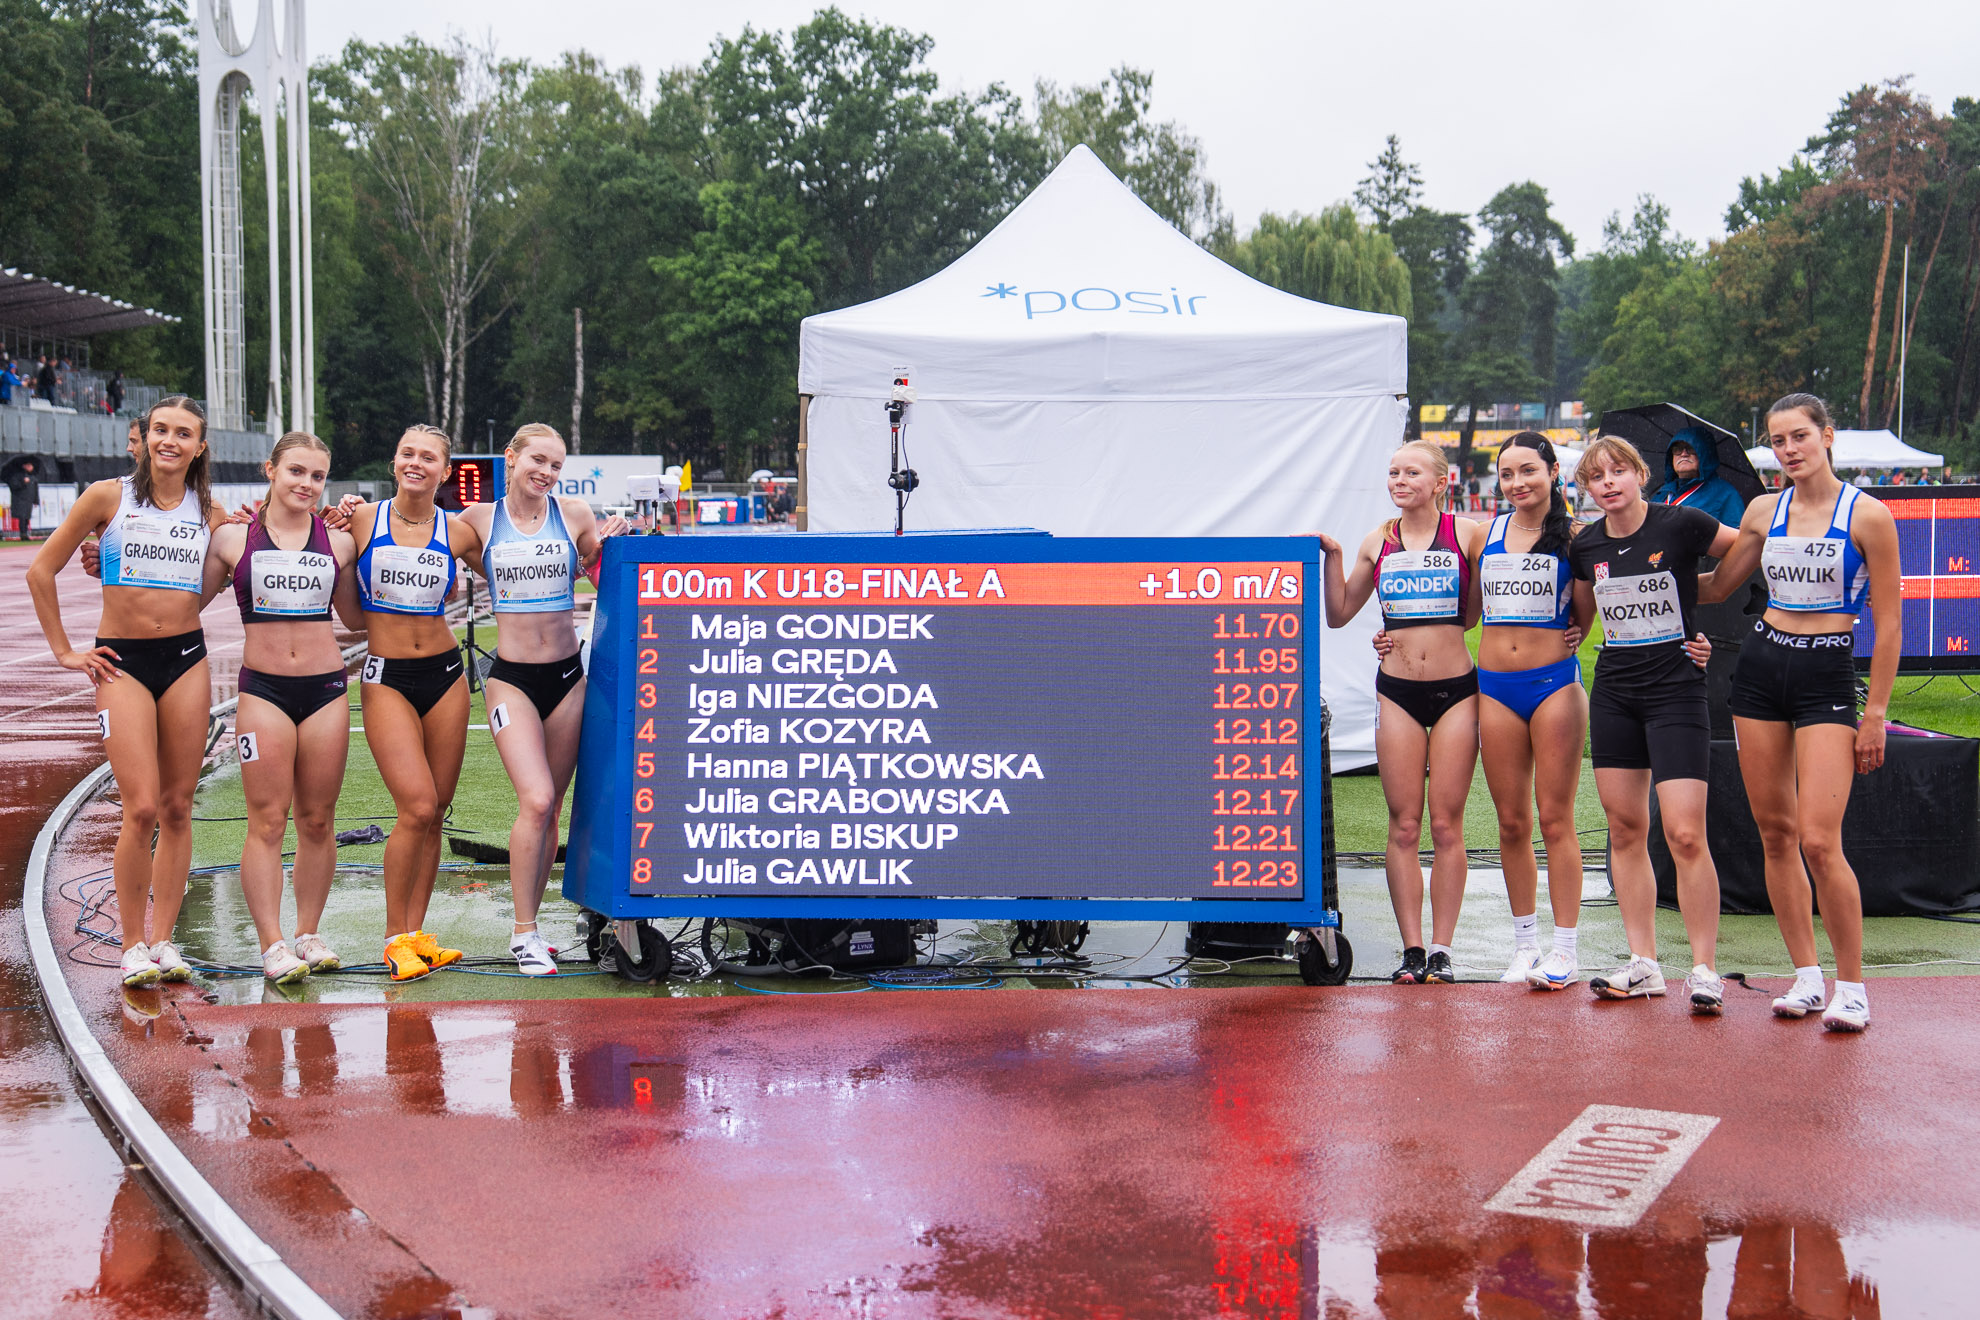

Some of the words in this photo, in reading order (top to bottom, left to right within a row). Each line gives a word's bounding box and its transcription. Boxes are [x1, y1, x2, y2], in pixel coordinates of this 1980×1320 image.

[169, 526, 197, 540] 657
[124, 543, 200, 565] GRABOWSKA
[535, 544, 562, 556] 241
[1804, 543, 1836, 557] 475
[298, 555, 327, 568] 460
[418, 553, 443, 568] 685
[1423, 555, 1452, 568] 586
[1522, 558, 1551, 571] 264
[1949, 556, 1970, 572] M:
[263, 574, 322, 593] GRĘDA
[380, 569, 440, 589] BISKUP
[495, 563, 568, 584] PIĄTKOWSKA
[1140, 569, 1221, 598] +1.0
[1234, 568, 1297, 598] m/s
[1767, 565, 1836, 584] GAWLIK
[641, 570, 731, 598] 100m
[744, 570, 767, 598] K
[778, 570, 968, 597] U18-FINAŁ
[977, 570, 1004, 597] A
[1382, 576, 1455, 594] GONDEK
[1483, 581, 1554, 596] NIEZGODA
[1638, 576, 1669, 593] 686
[1602, 600, 1675, 621] KOZYRA
[641, 615, 658, 639] 1
[692, 615, 766, 646] Maja
[777, 615, 934, 639] GONDEK
[1213, 613, 1299, 639] 11.70
[1766, 629, 1810, 649] NIKE
[1811, 635, 1851, 649] PRO
[1947, 636, 1969, 651] M:
[366, 657, 379, 680] 5
[639, 650, 658, 674] 2
[690, 649, 762, 673] Julia
[772, 649, 897, 681] GRĘDA
[1213, 648, 1297, 674] 11.95
[639, 683, 657, 708] 3
[690, 684, 736, 715] Iga
[748, 684, 938, 708] NIEZGODA
[1213, 683, 1299, 709] 12.07
[637, 718, 657, 743] 4
[688, 719, 769, 743] Zofia
[781, 719, 931, 743] KOZYRA
[1213, 719, 1297, 744] 12.12
[240, 736, 252, 760] 3
[636, 753, 655, 778] 5
[688, 753, 787, 778] Hanna
[799, 754, 1044, 786] PIĄTKOWSKA
[1213, 754, 1299, 780] 12.14
[635, 788, 654, 813] 6
[686, 788, 758, 813] Julia
[769, 789, 1010, 814] GRABOWSKA
[1212, 789, 1299, 815] 12.17
[636, 823, 654, 848] 7
[684, 823, 819, 848] Wiktoria
[831, 824, 958, 849] BISKUP
[1212, 825, 1297, 851] 12.21
[633, 858, 652, 883] 8
[684, 858, 756, 883] Julia
[767, 859, 913, 884] GAWLIK
[1212, 861, 1298, 887] 12.23
[1514, 1123, 1681, 1212] CONICA
